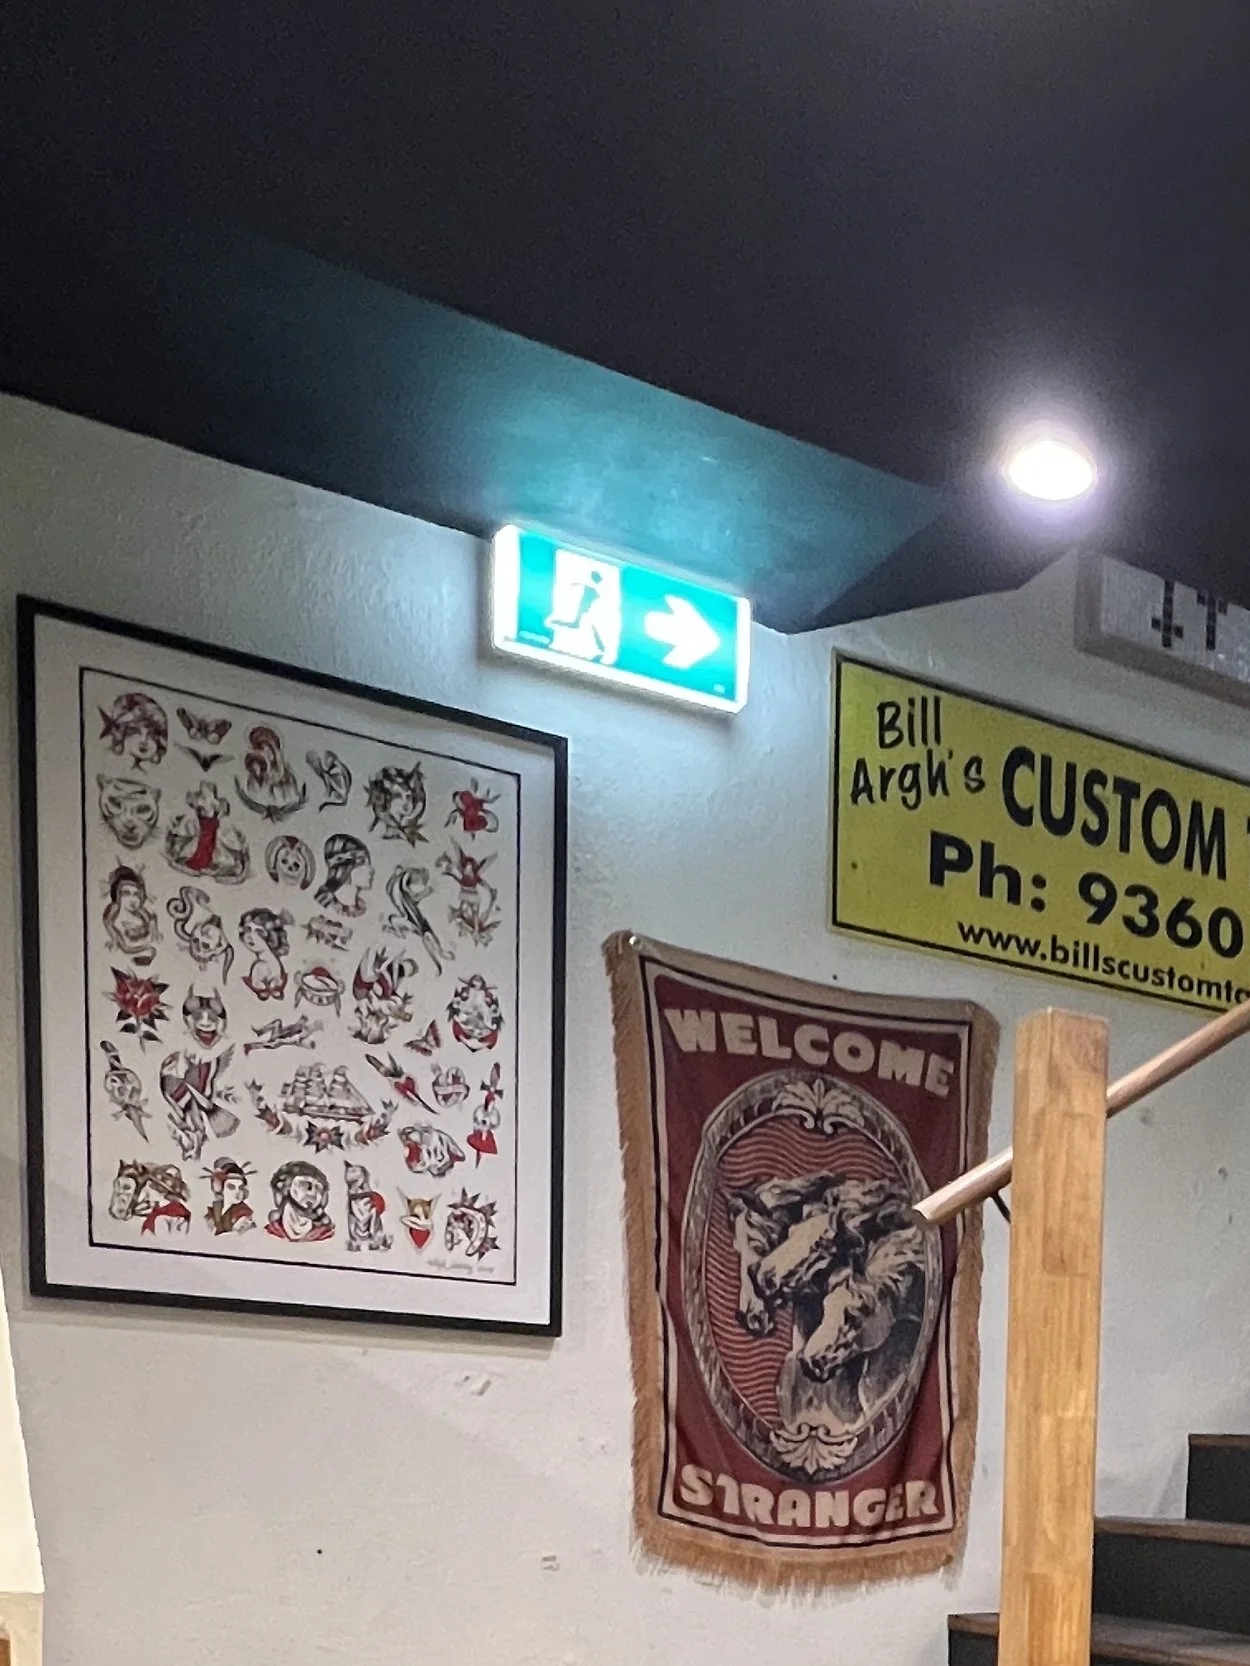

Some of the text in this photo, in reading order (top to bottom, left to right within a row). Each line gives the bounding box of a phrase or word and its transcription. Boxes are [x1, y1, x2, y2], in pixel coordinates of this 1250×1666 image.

[876, 696, 942, 750] Bill
[850, 747, 987, 811] Argh's
[1001, 744, 1229, 882] CUSTOM
[928, 829, 1048, 914] Ph:
[1077, 870, 1245, 960] 9360
[663, 1008, 955, 1097] WELCOME
[679, 1464, 938, 1530] STRANGER
